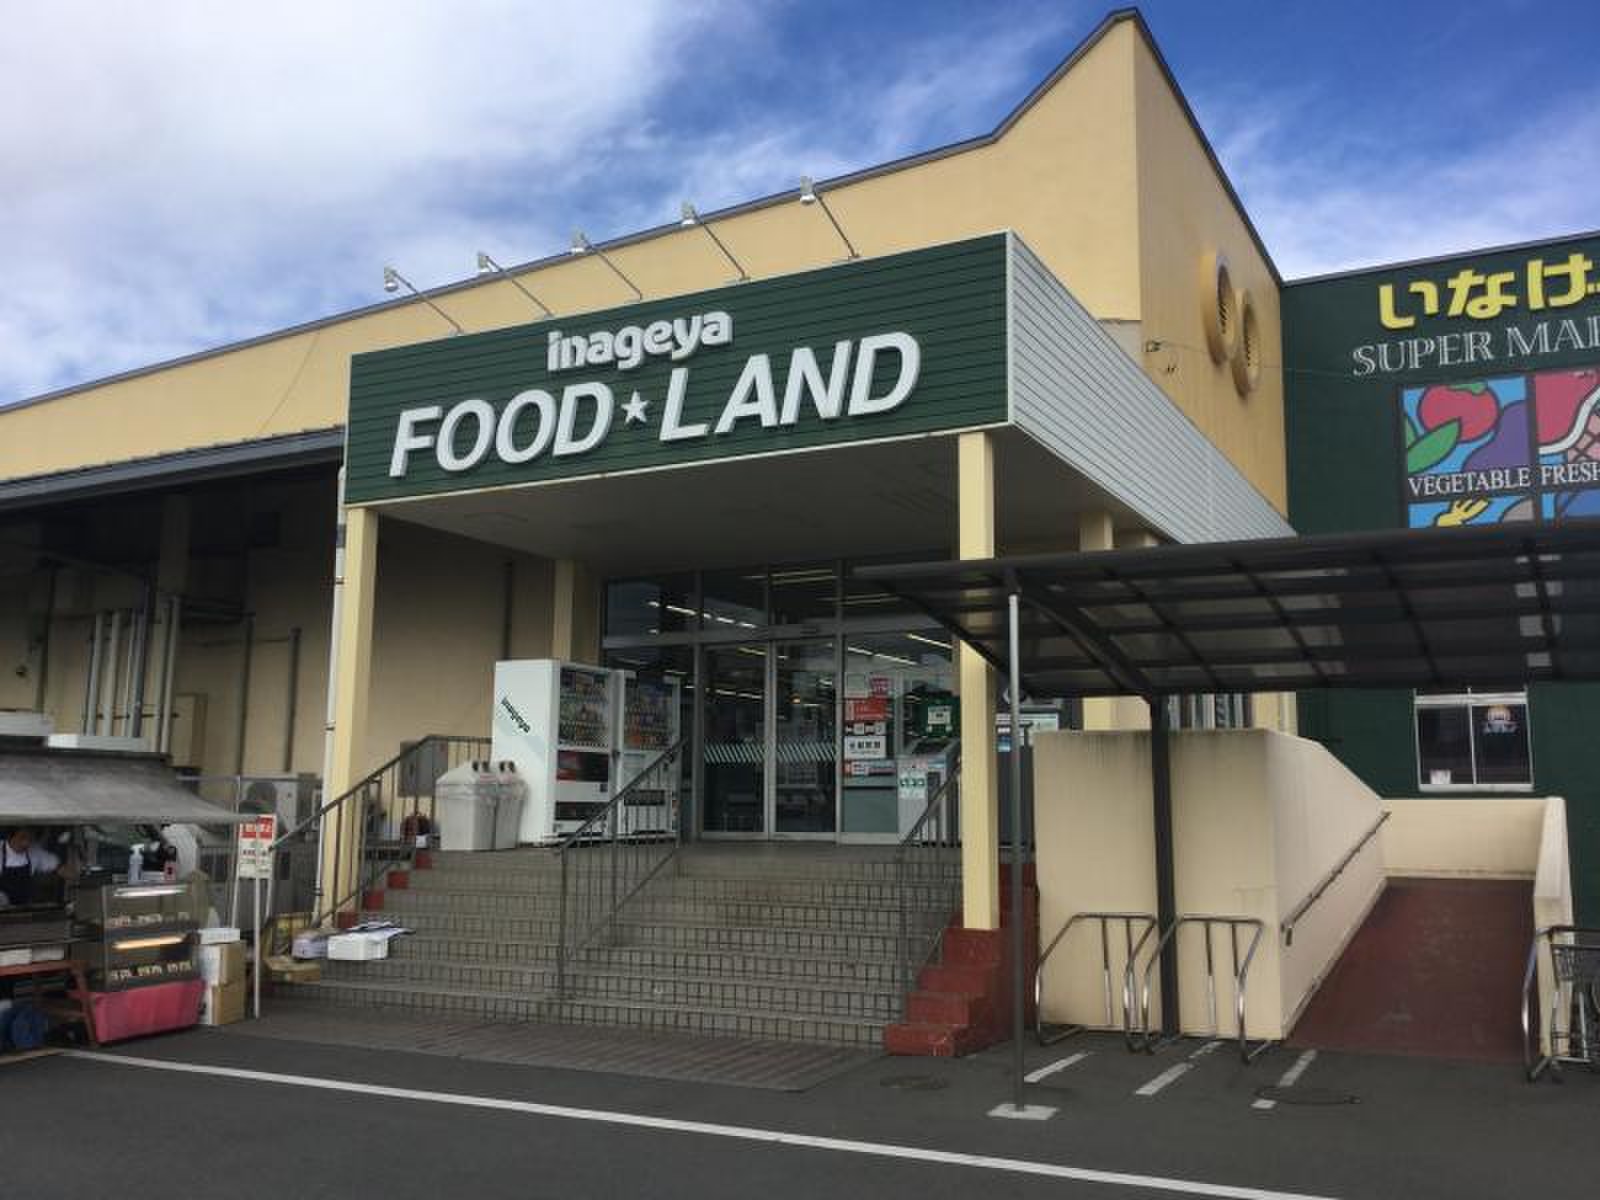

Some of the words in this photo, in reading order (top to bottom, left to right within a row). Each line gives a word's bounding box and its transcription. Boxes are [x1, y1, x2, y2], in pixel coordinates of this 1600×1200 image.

[547, 310, 733, 372] inageya
[1352, 331, 1494, 376] SUPER
[389, 381, 614, 477] FOOD
[659, 331, 921, 442] LAND
[1408, 466, 1531, 496] VEGETABLE
